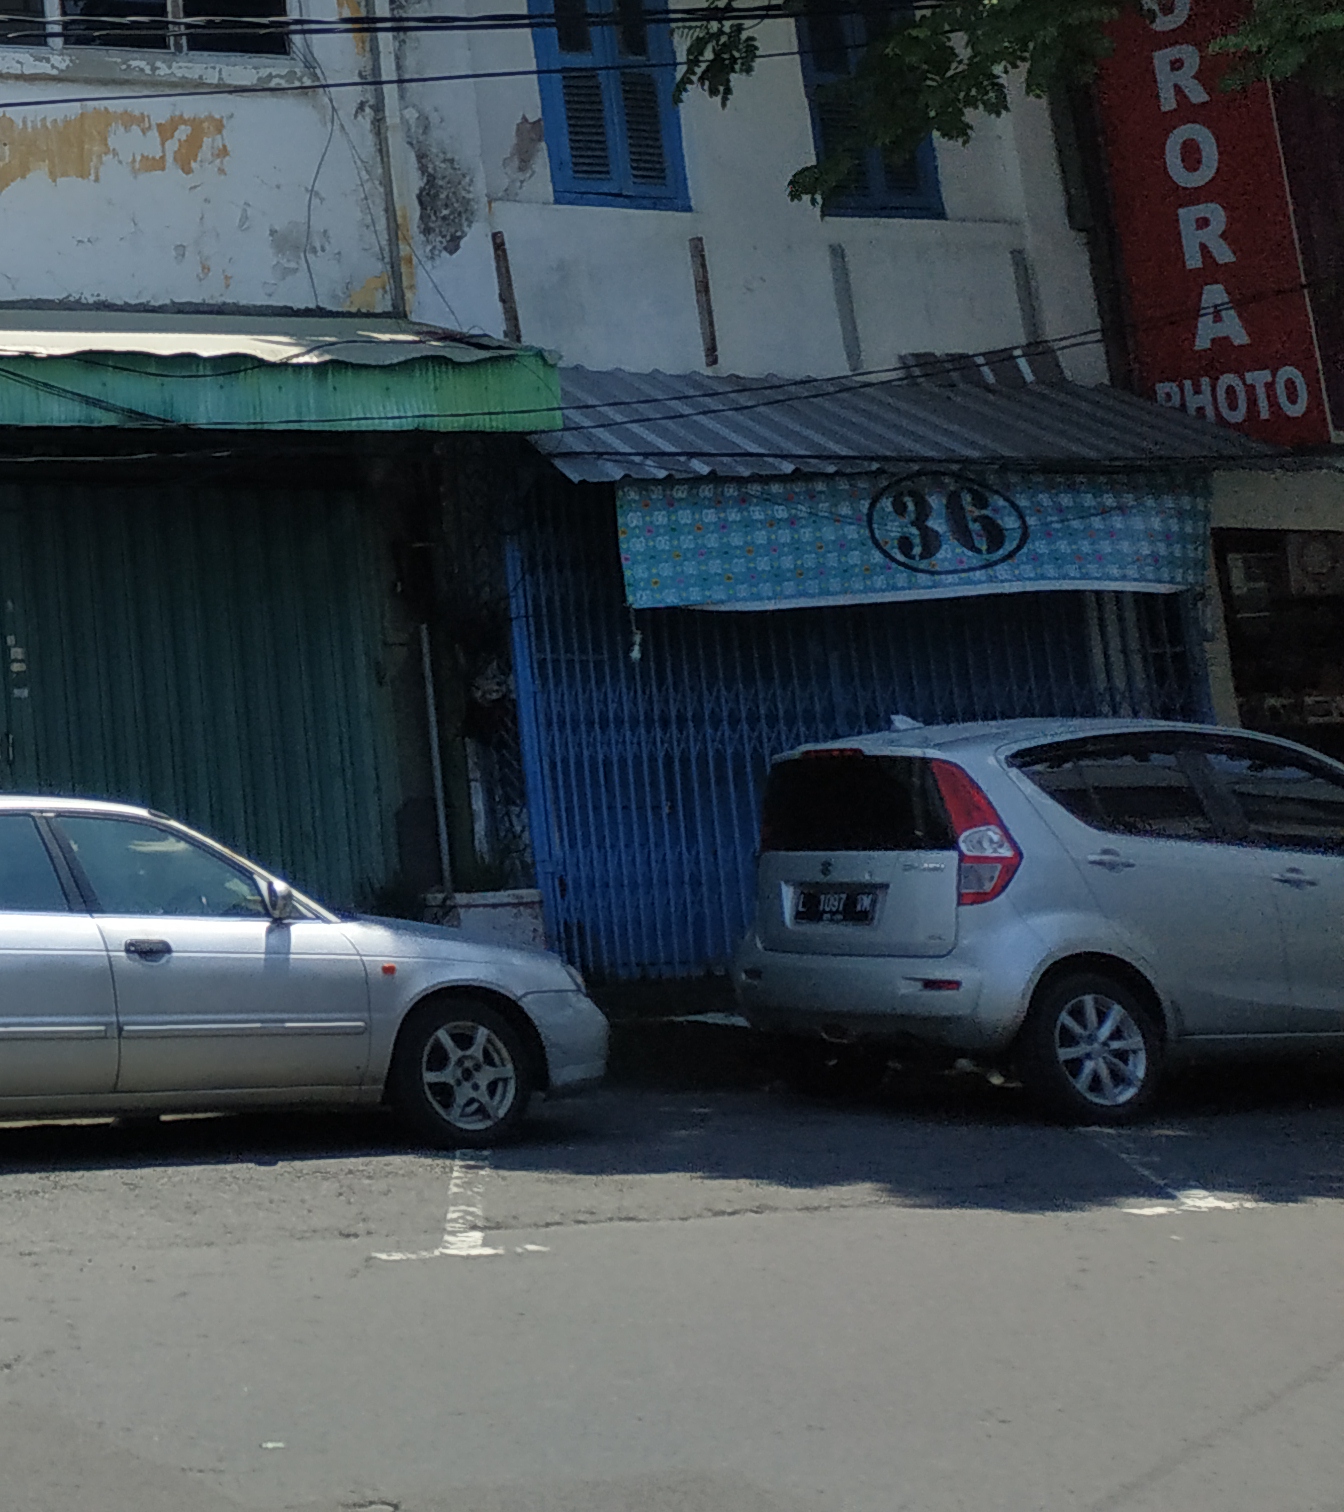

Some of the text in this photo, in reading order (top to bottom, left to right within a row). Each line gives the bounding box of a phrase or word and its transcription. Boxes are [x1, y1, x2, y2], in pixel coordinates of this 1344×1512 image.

[1155, 366, 1308, 424] PHOTO
[891, 487, 1006, 561] 36
[798, 893, 807, 912] L
[819, 893, 847, 912] 1097
